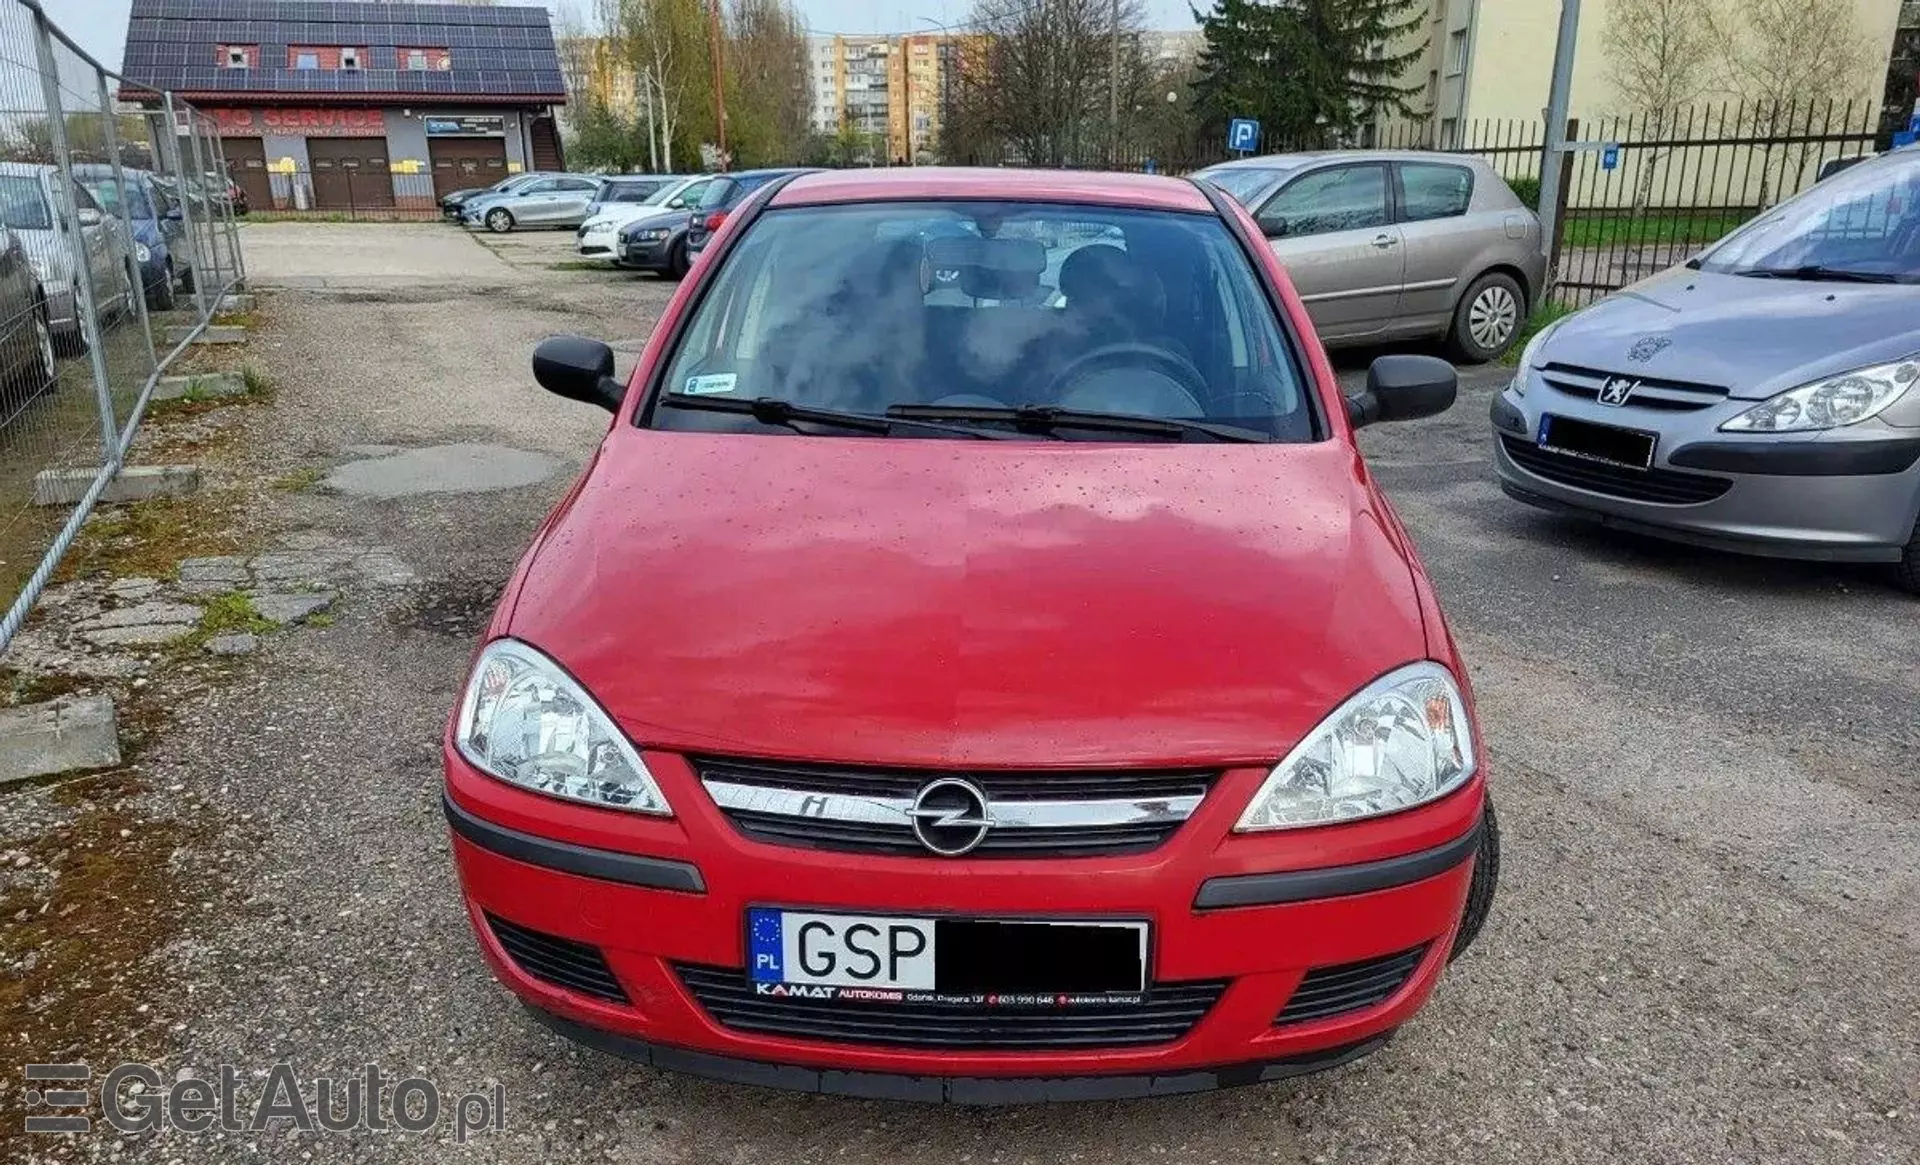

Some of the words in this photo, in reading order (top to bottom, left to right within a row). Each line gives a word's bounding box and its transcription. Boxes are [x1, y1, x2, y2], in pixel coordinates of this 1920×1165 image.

[261, 108, 384, 126] SERVICE
[342, 127, 386, 138] SERWIS
[1235, 123, 1252, 147] P
[756, 953, 779, 970] PL
[756, 982, 836, 998] KAMAT
[838, 989, 903, 1001] AUTOKOMIS
[1017, 995, 1034, 1005] 990
[1036, 995, 1054, 1005] 646
